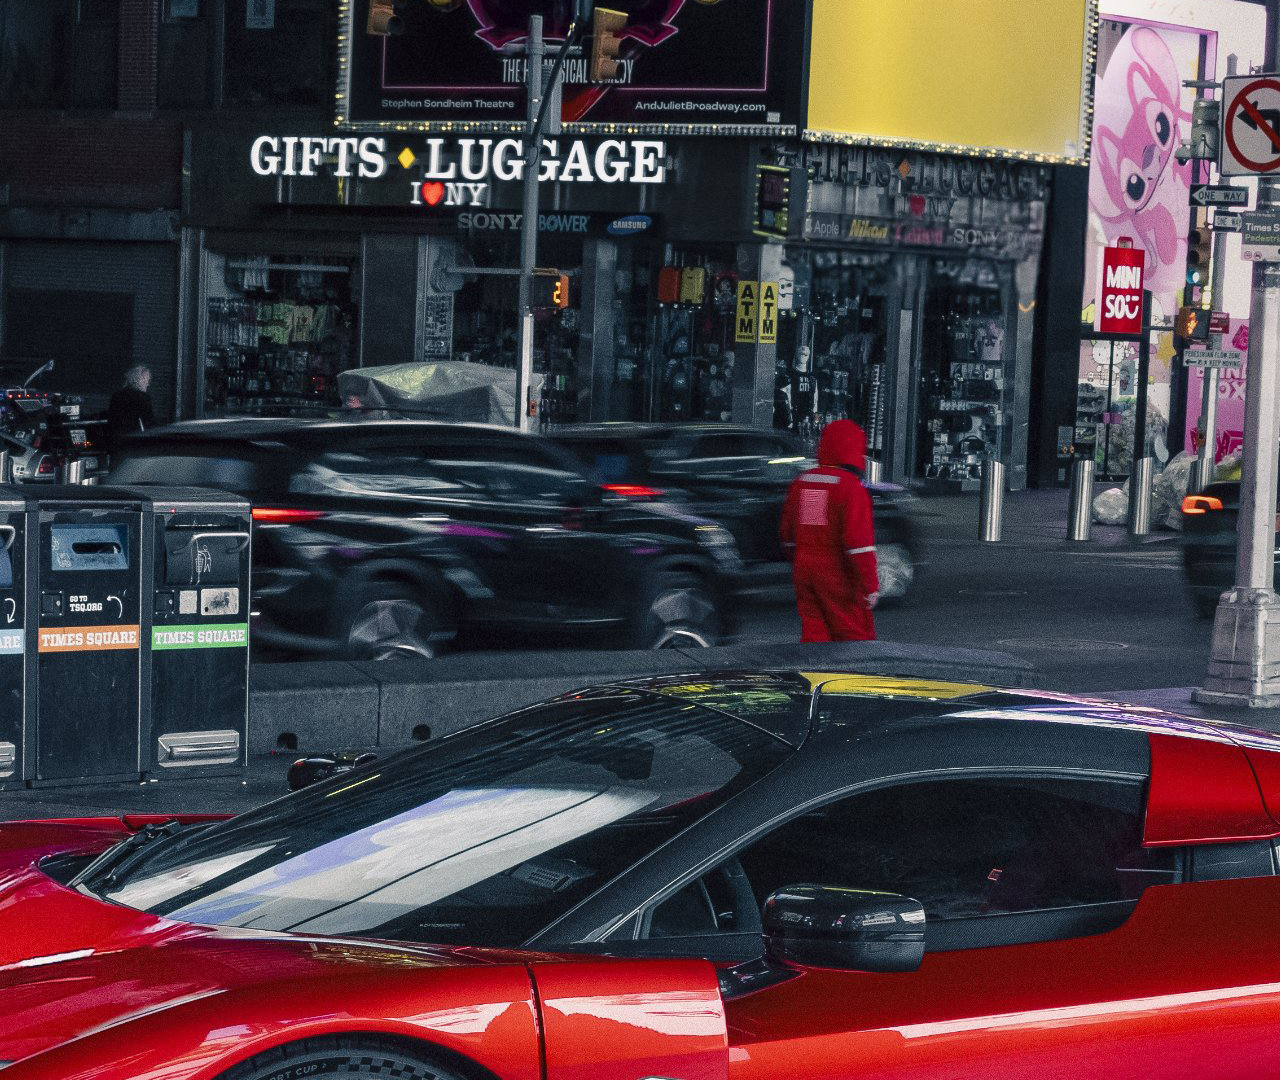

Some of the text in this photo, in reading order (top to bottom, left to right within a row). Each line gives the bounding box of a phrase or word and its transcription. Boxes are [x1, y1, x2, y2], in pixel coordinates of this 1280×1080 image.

[503, 59, 520, 83] THE
[381, 99, 515, 109] Stephen Sondheim Theatre
[634, 101, 766, 112] AndJulietBroadway.com
[250, 135, 666, 184] GIFTS LUGGAGE
[444, 183, 487, 206] NY
[1199, 191, 1242, 200] ONE WAY
[458, 213, 523, 231] SONY
[613, 220, 647, 231] SAMSUNG
[1245, 222, 1271, 232] Times
[814, 219, 839, 235] Apple
[849, 219, 888, 238] Nikon
[953, 228, 1001, 243] SONY
[1106, 265, 1141, 289] MINI
[740, 284, 755, 334] ATM
[763, 285, 775, 335] ATM
[70, 603, 102, 611] TSQ.ORG
[42, 630, 136, 647] TIMES SQUARE
[154, 629, 245, 644] TIMES SQUARE
[295, 1064, 318, 1077] CUP
